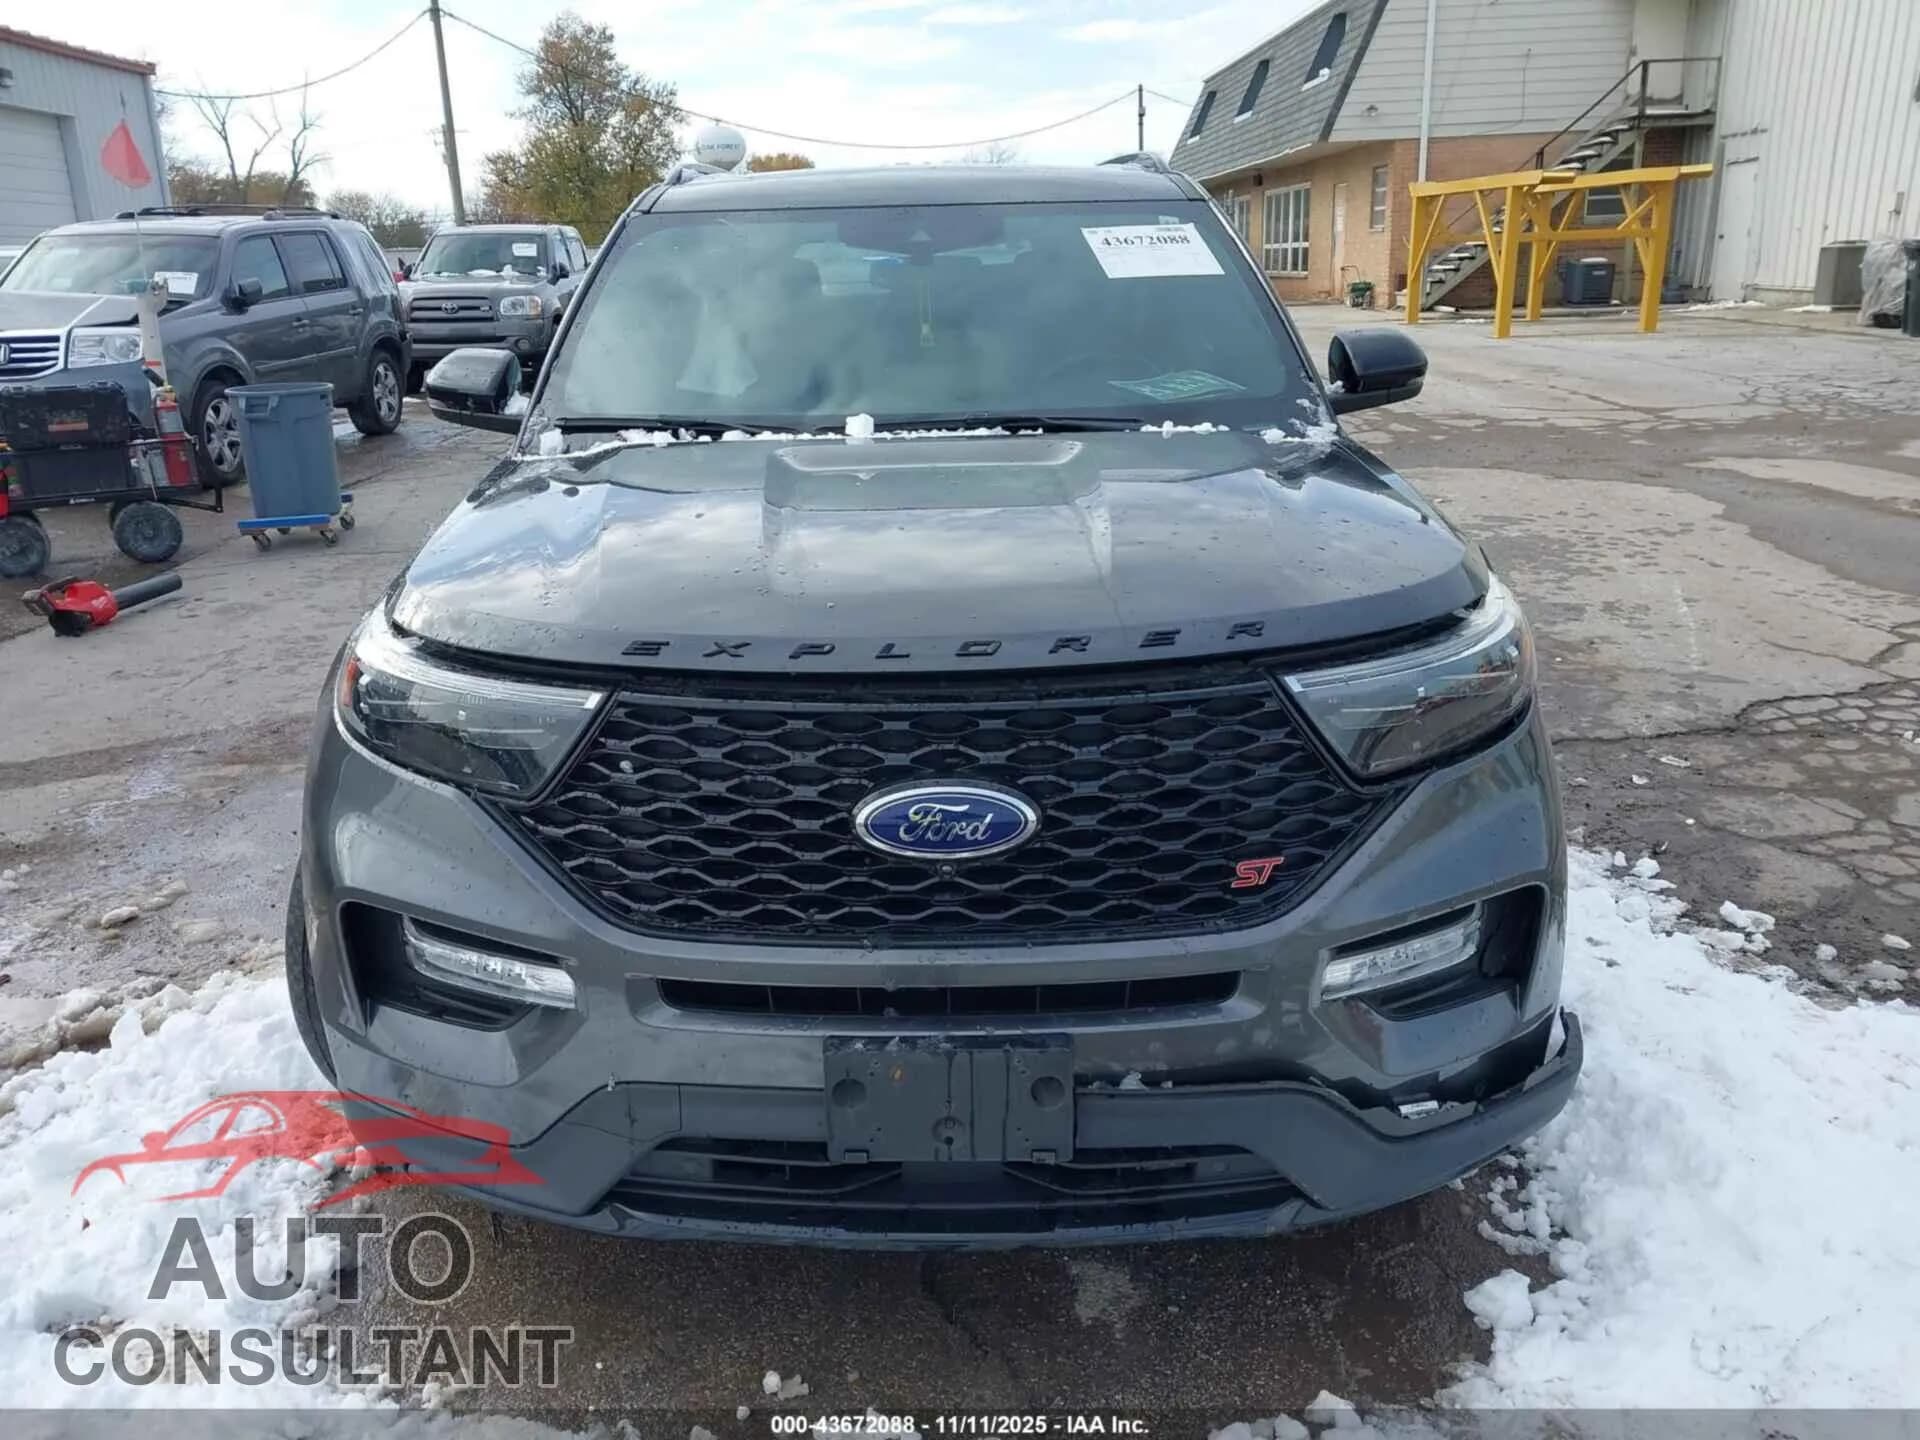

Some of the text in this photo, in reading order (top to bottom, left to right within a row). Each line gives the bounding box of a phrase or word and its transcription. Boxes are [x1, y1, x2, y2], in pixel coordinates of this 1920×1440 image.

[1101, 234, 1191, 247] 43672088
[620, 620, 1265, 658] EXPLORER
[899, 803, 993, 843] Ford
[1231, 857, 1285, 888] ST
